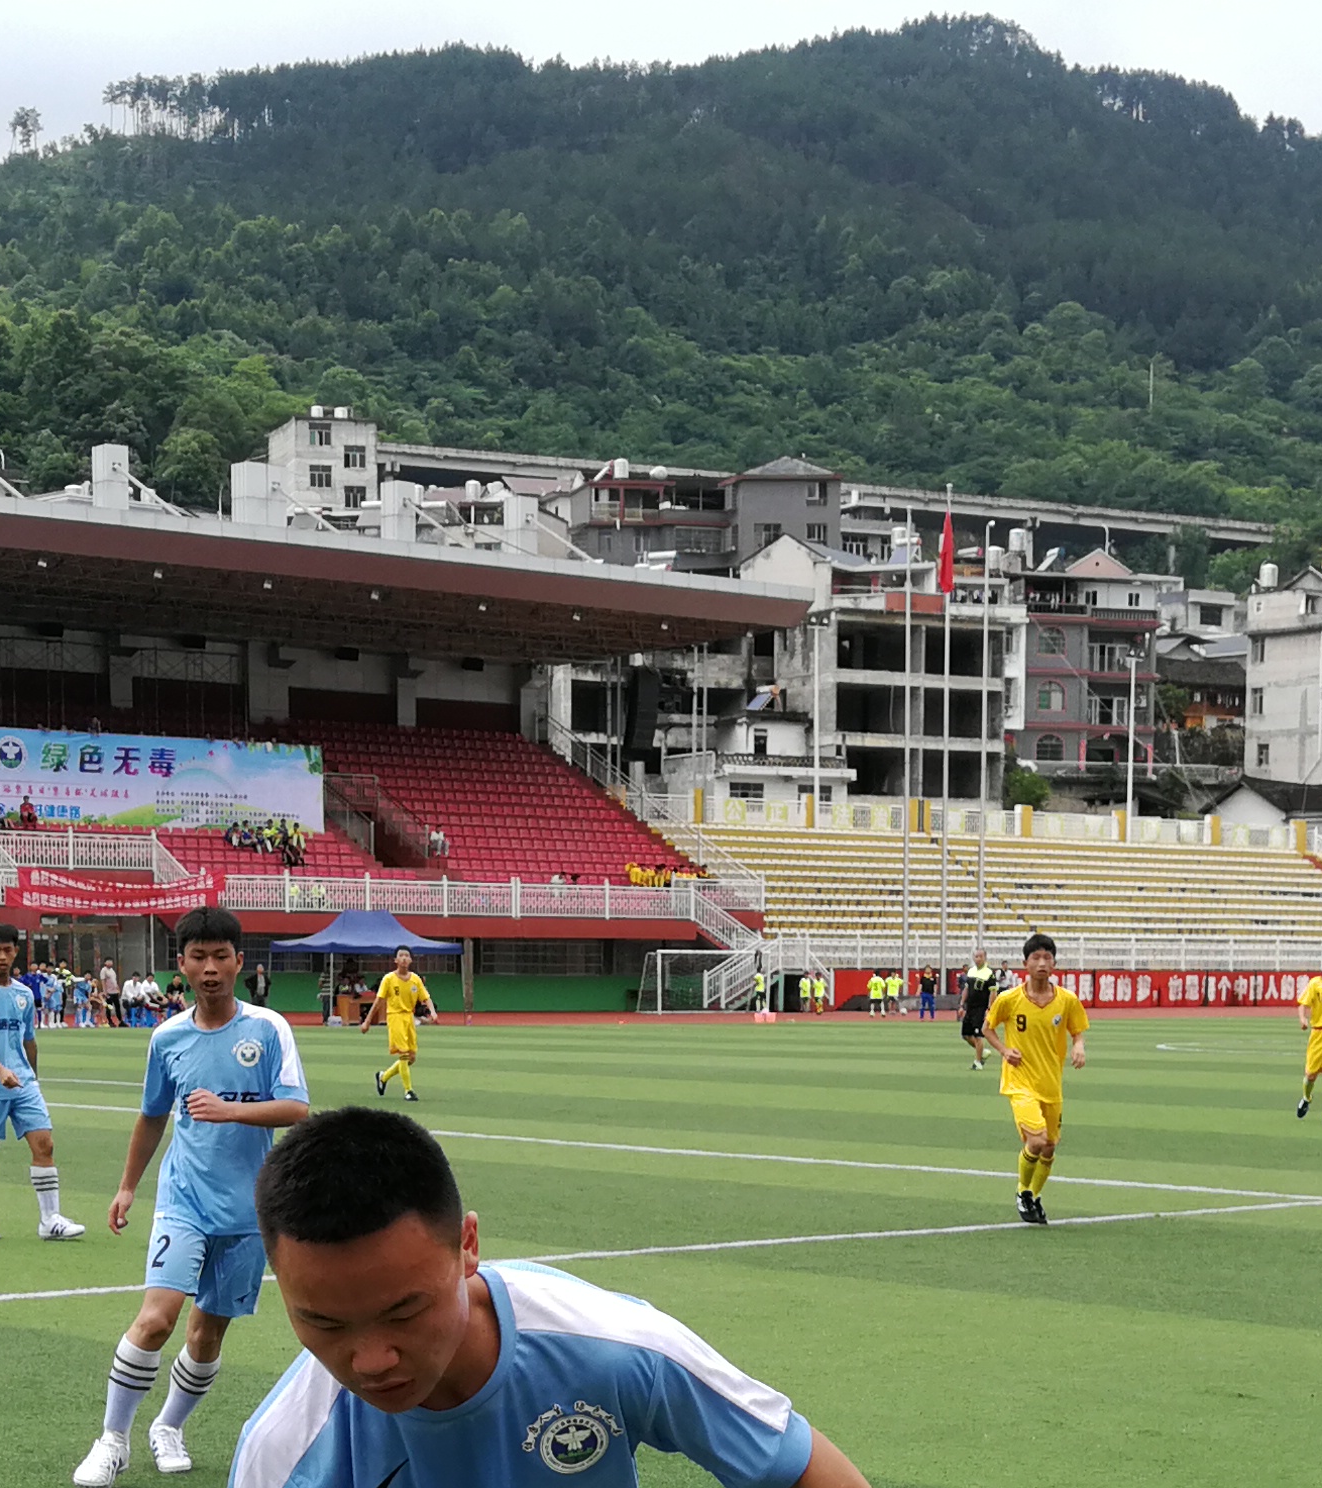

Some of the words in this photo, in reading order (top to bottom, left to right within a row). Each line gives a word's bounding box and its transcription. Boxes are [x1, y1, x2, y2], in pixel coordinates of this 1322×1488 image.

[41, 741, 178, 778] 绿色无毒
[1016, 1014, 1027, 1033] 9
[151, 1234, 171, 1269] 2
